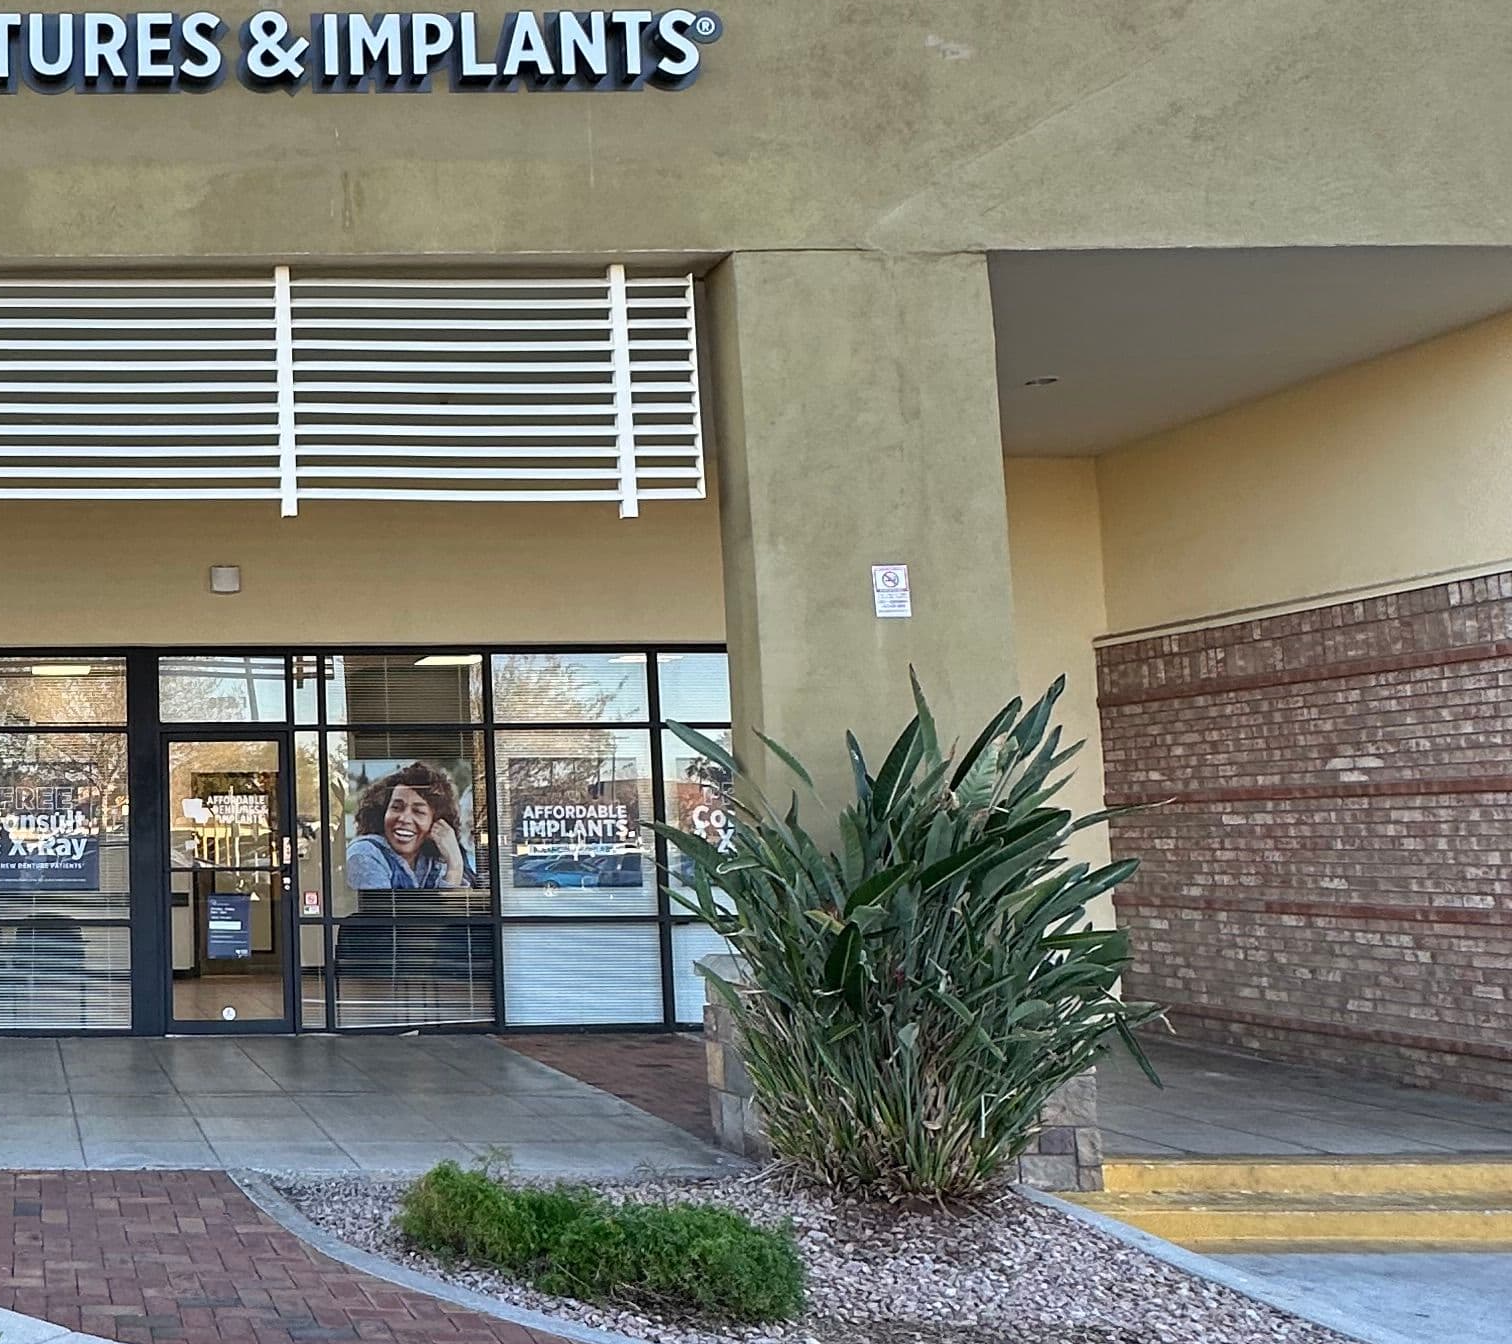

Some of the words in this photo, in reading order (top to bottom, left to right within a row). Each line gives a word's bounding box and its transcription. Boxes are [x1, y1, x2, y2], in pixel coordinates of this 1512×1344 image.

[246, 9, 311, 79] &
[207, 795, 265, 805] AFFORDABLE
[523, 805, 627, 819] AFFORDABLE
[523, 820, 635, 838] IMPLANTS.
[8, 836, 88, 860] X-Ray
